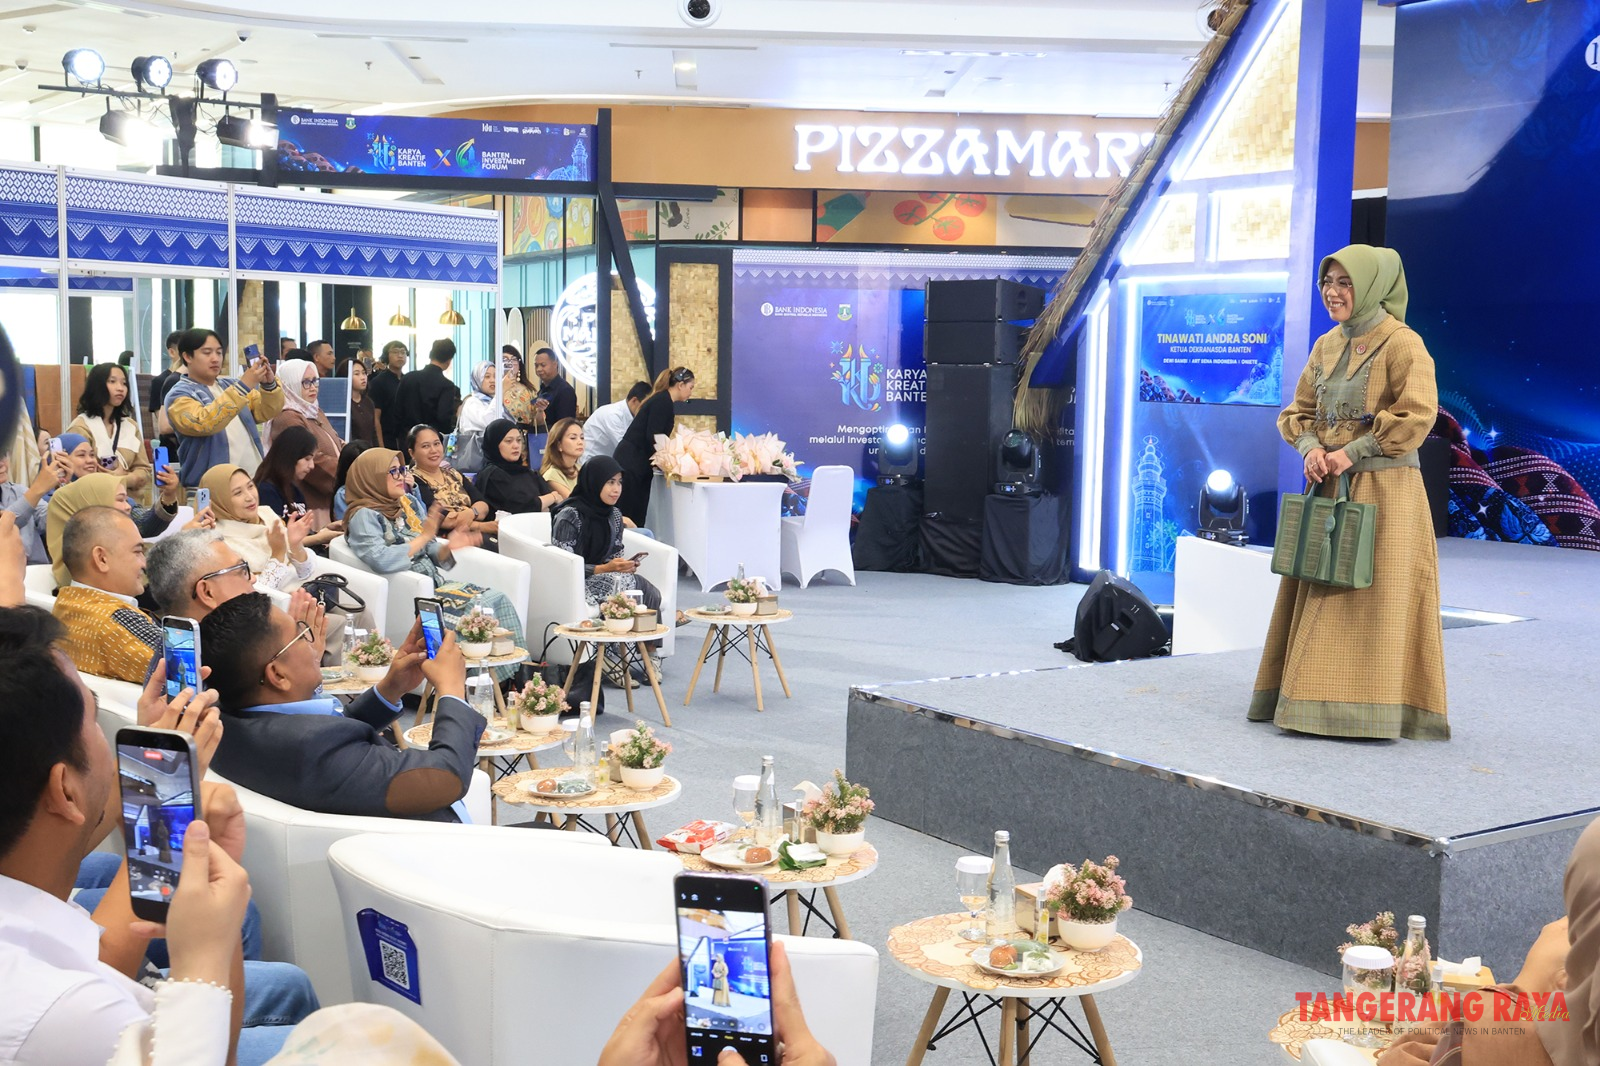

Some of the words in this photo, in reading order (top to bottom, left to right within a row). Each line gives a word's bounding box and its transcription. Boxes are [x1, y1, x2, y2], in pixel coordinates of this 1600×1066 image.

[794, 124, 1156, 178] PIZZAMAR
[793, 306, 828, 314] INDONESIA
[1157, 333, 1204, 344] TINAWATI
[1205, 333, 1240, 344] ANDRA
[1242, 333, 1267, 344] SONI
[886, 368, 927, 379] KARYA
[886, 380, 926, 390] KREAT
[886, 391, 927, 402] BANTE
[809, 435, 845, 444] melalui
